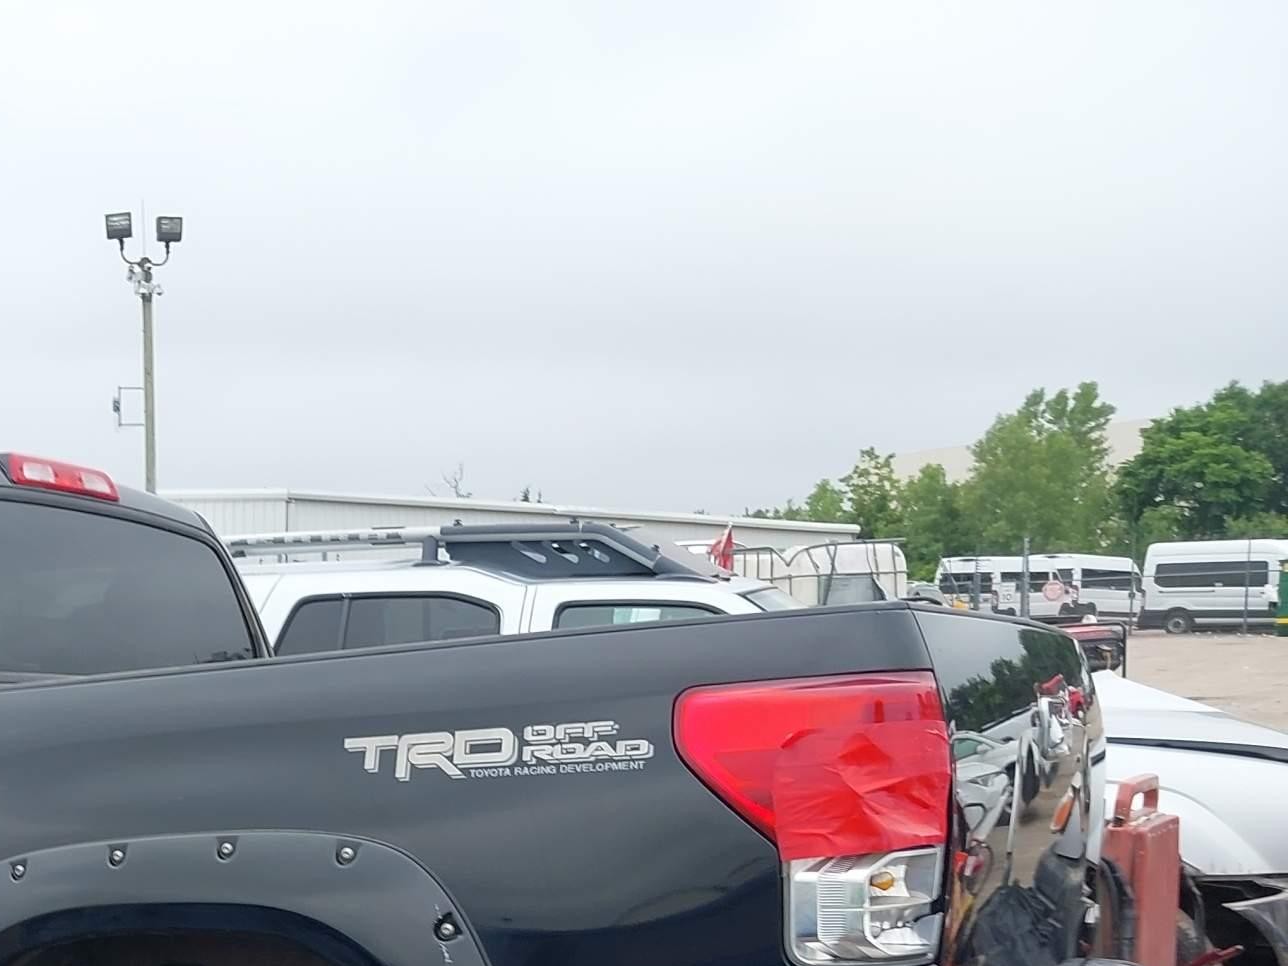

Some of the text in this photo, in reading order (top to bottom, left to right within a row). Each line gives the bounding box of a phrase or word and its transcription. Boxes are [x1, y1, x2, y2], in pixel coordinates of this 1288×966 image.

[523, 720, 620, 743] OFF
[343, 727, 519, 782] TRD
[522, 739, 654, 765] ROAD
[469, 760, 646, 779] TOYOTA RACING DEVELOPMENT
